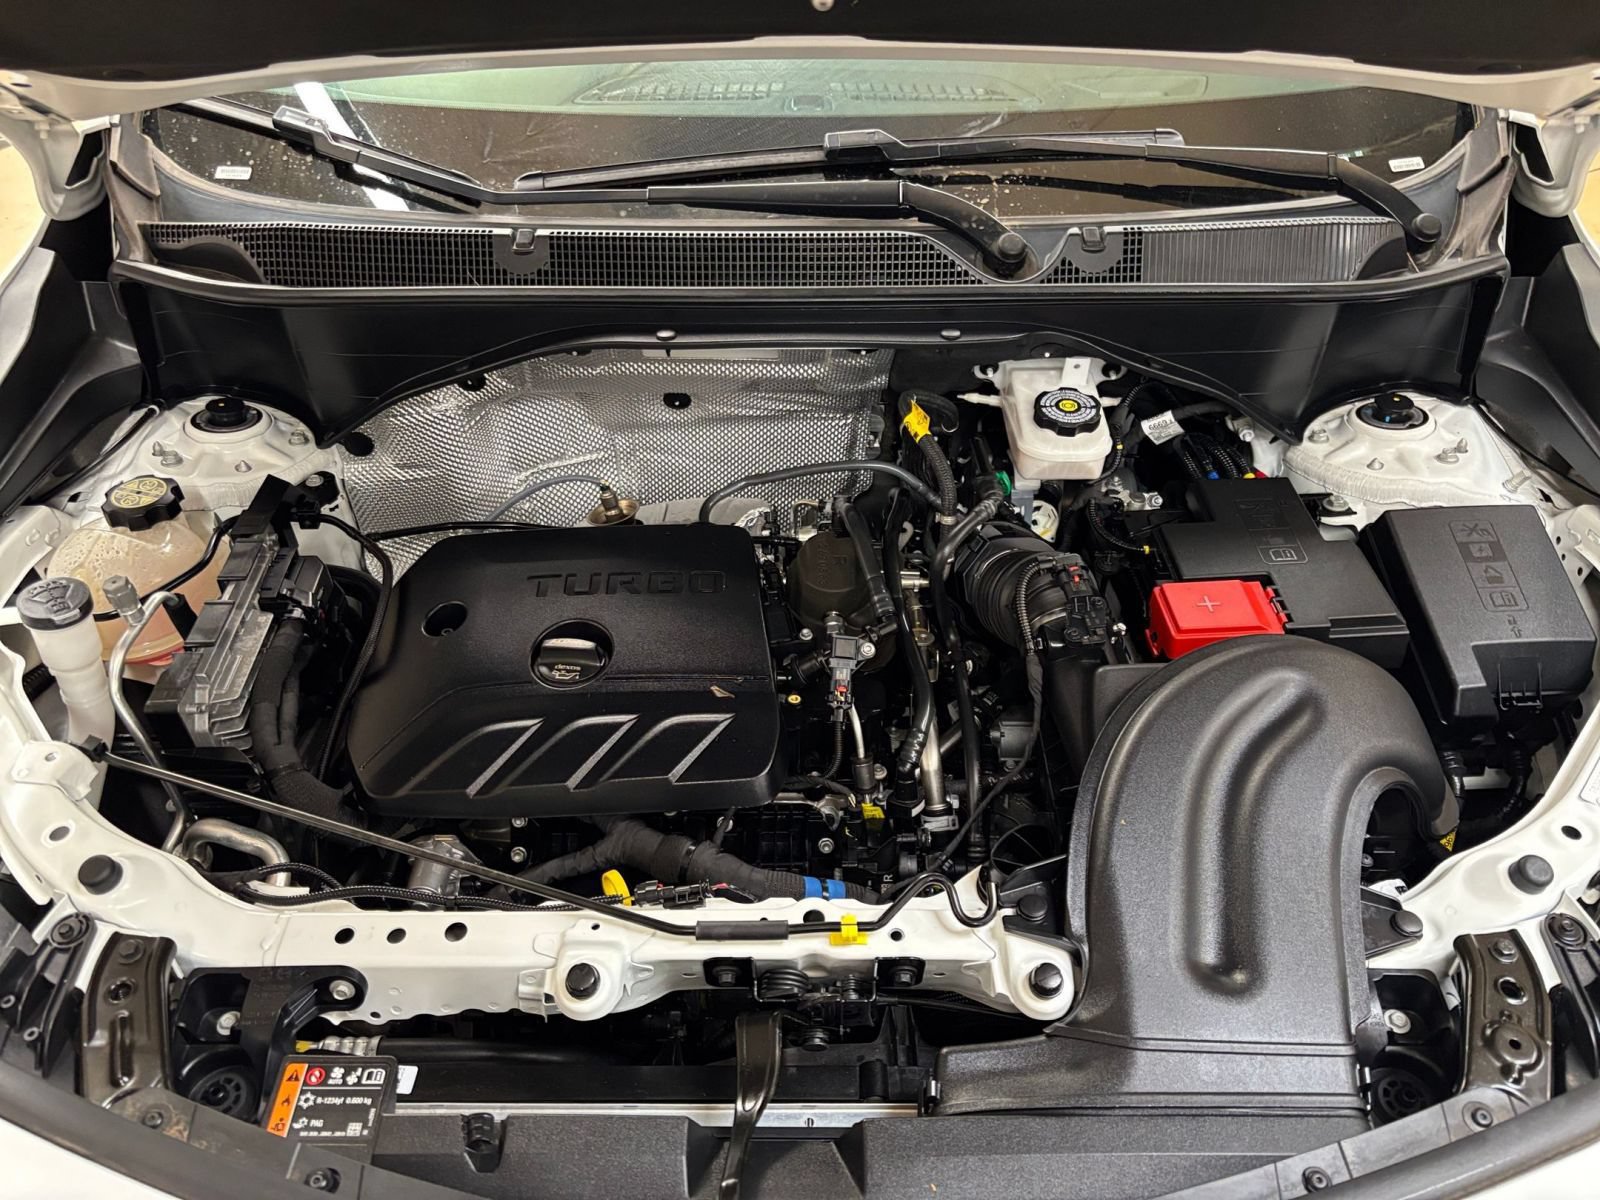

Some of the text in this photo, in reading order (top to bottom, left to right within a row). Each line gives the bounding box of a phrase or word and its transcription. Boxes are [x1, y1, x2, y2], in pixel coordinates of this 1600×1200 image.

[527, 570, 726, 598] TURBO
[554, 663, 581, 671] dexos
[316, 1096, 344, 1106] R-1234yf
[363, 1096, 372, 1105] kg
[309, 1119, 324, 1127] PAG
